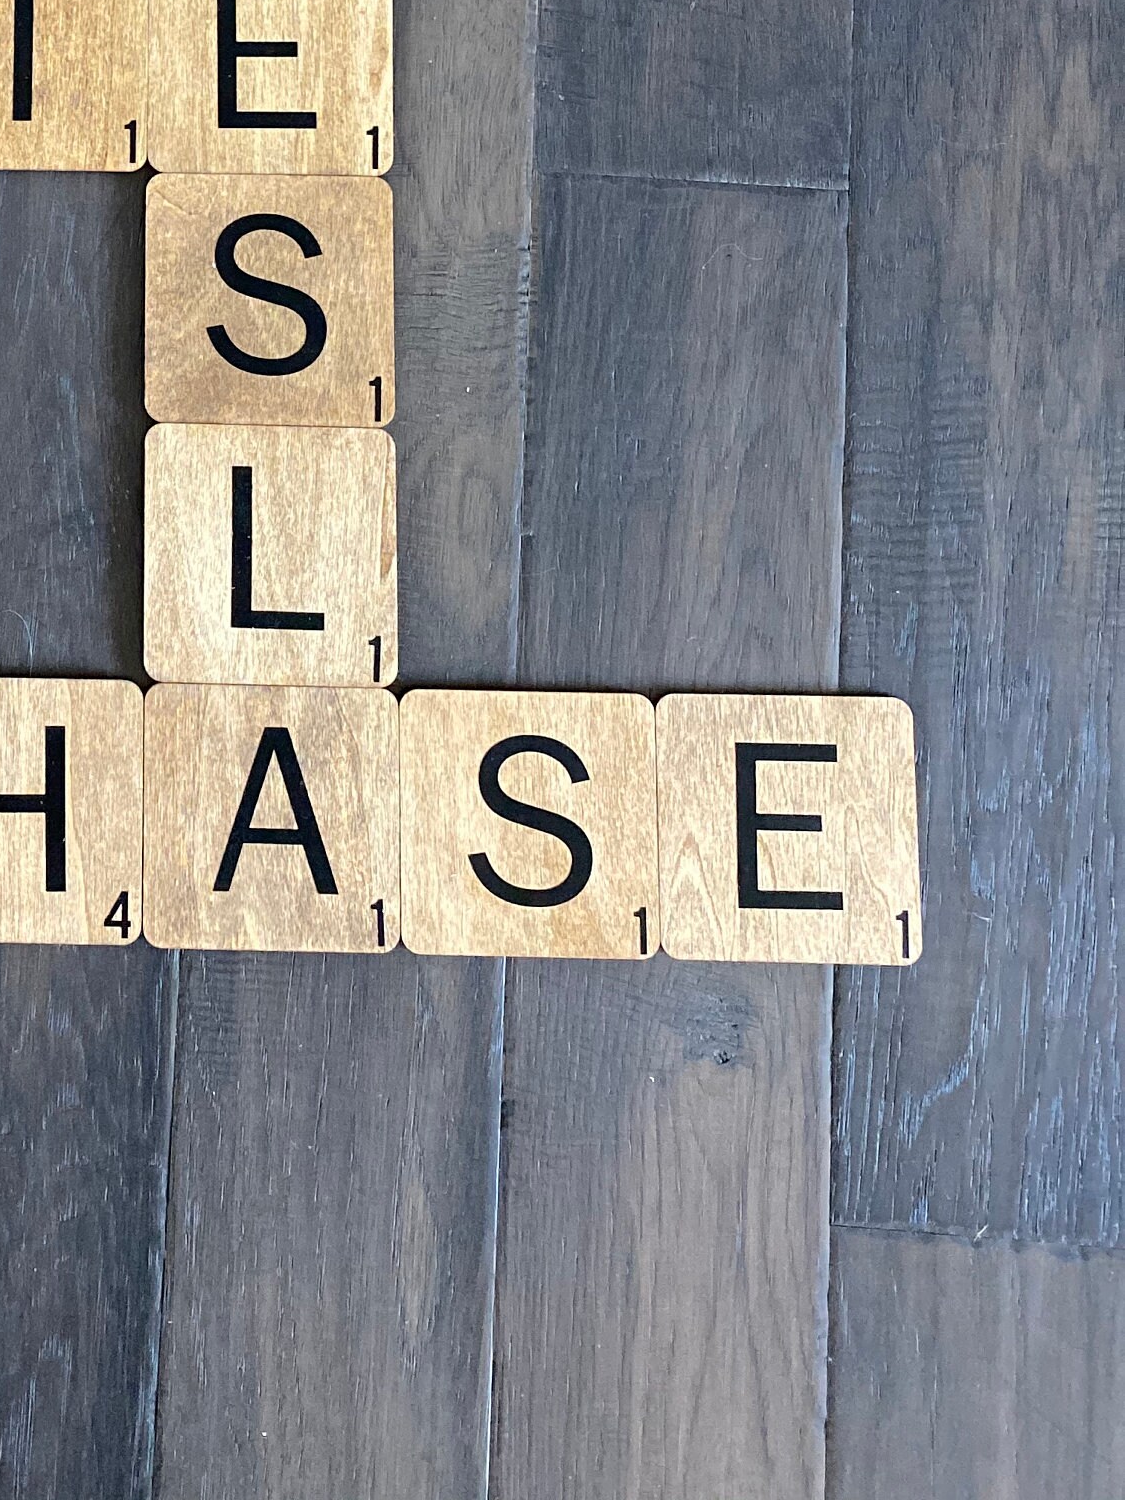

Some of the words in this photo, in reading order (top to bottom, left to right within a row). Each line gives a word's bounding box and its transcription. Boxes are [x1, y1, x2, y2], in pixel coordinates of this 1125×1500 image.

[125, 120, 136, 163] 1
[367, 126, 378, 169] 1
[369, 377, 381, 422] 1
[369, 636, 381, 682] 1
[104, 891, 131, 938] 4
[371, 899, 385, 946] 1
[634, 907, 647, 954] 1
[896, 911, 909, 959] 1
